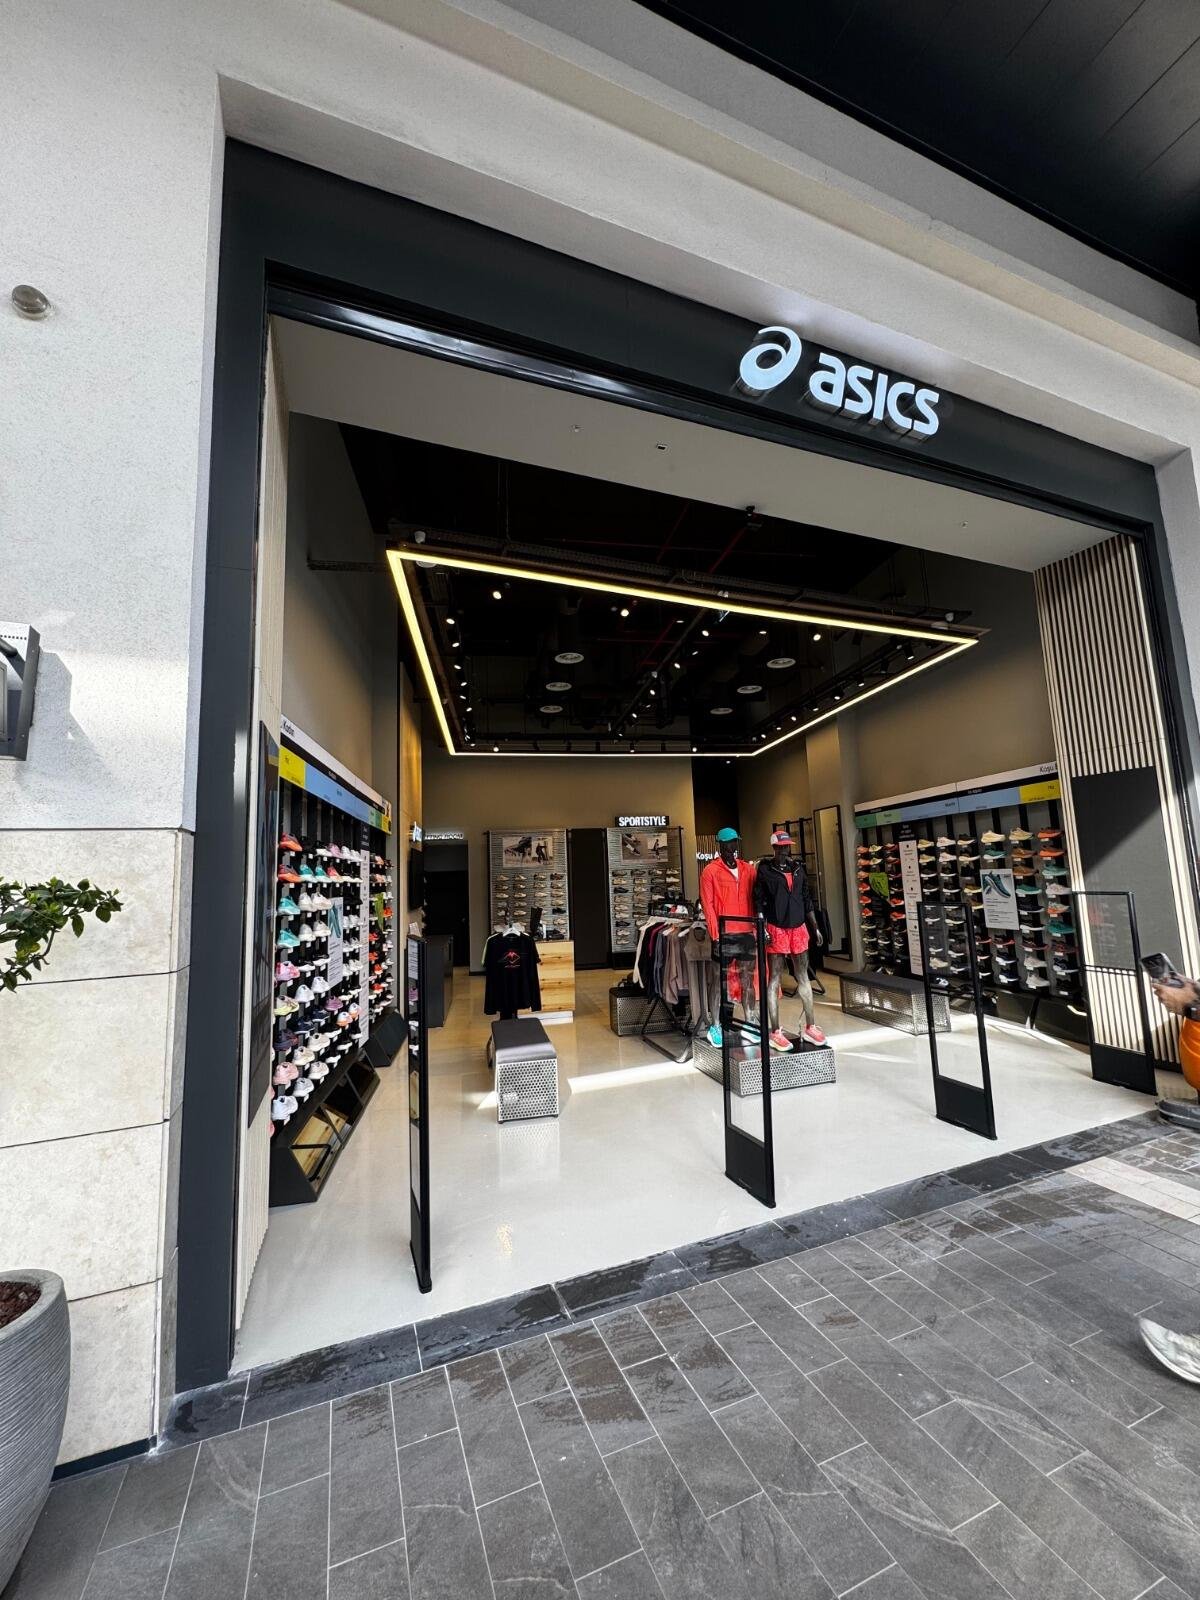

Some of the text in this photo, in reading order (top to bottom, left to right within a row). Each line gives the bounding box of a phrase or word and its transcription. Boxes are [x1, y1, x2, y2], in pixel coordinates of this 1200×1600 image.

[809, 352, 939, 435] asics
[618, 815, 666, 827] SPORTSTYLE
[695, 851, 713, 861] Koşu
